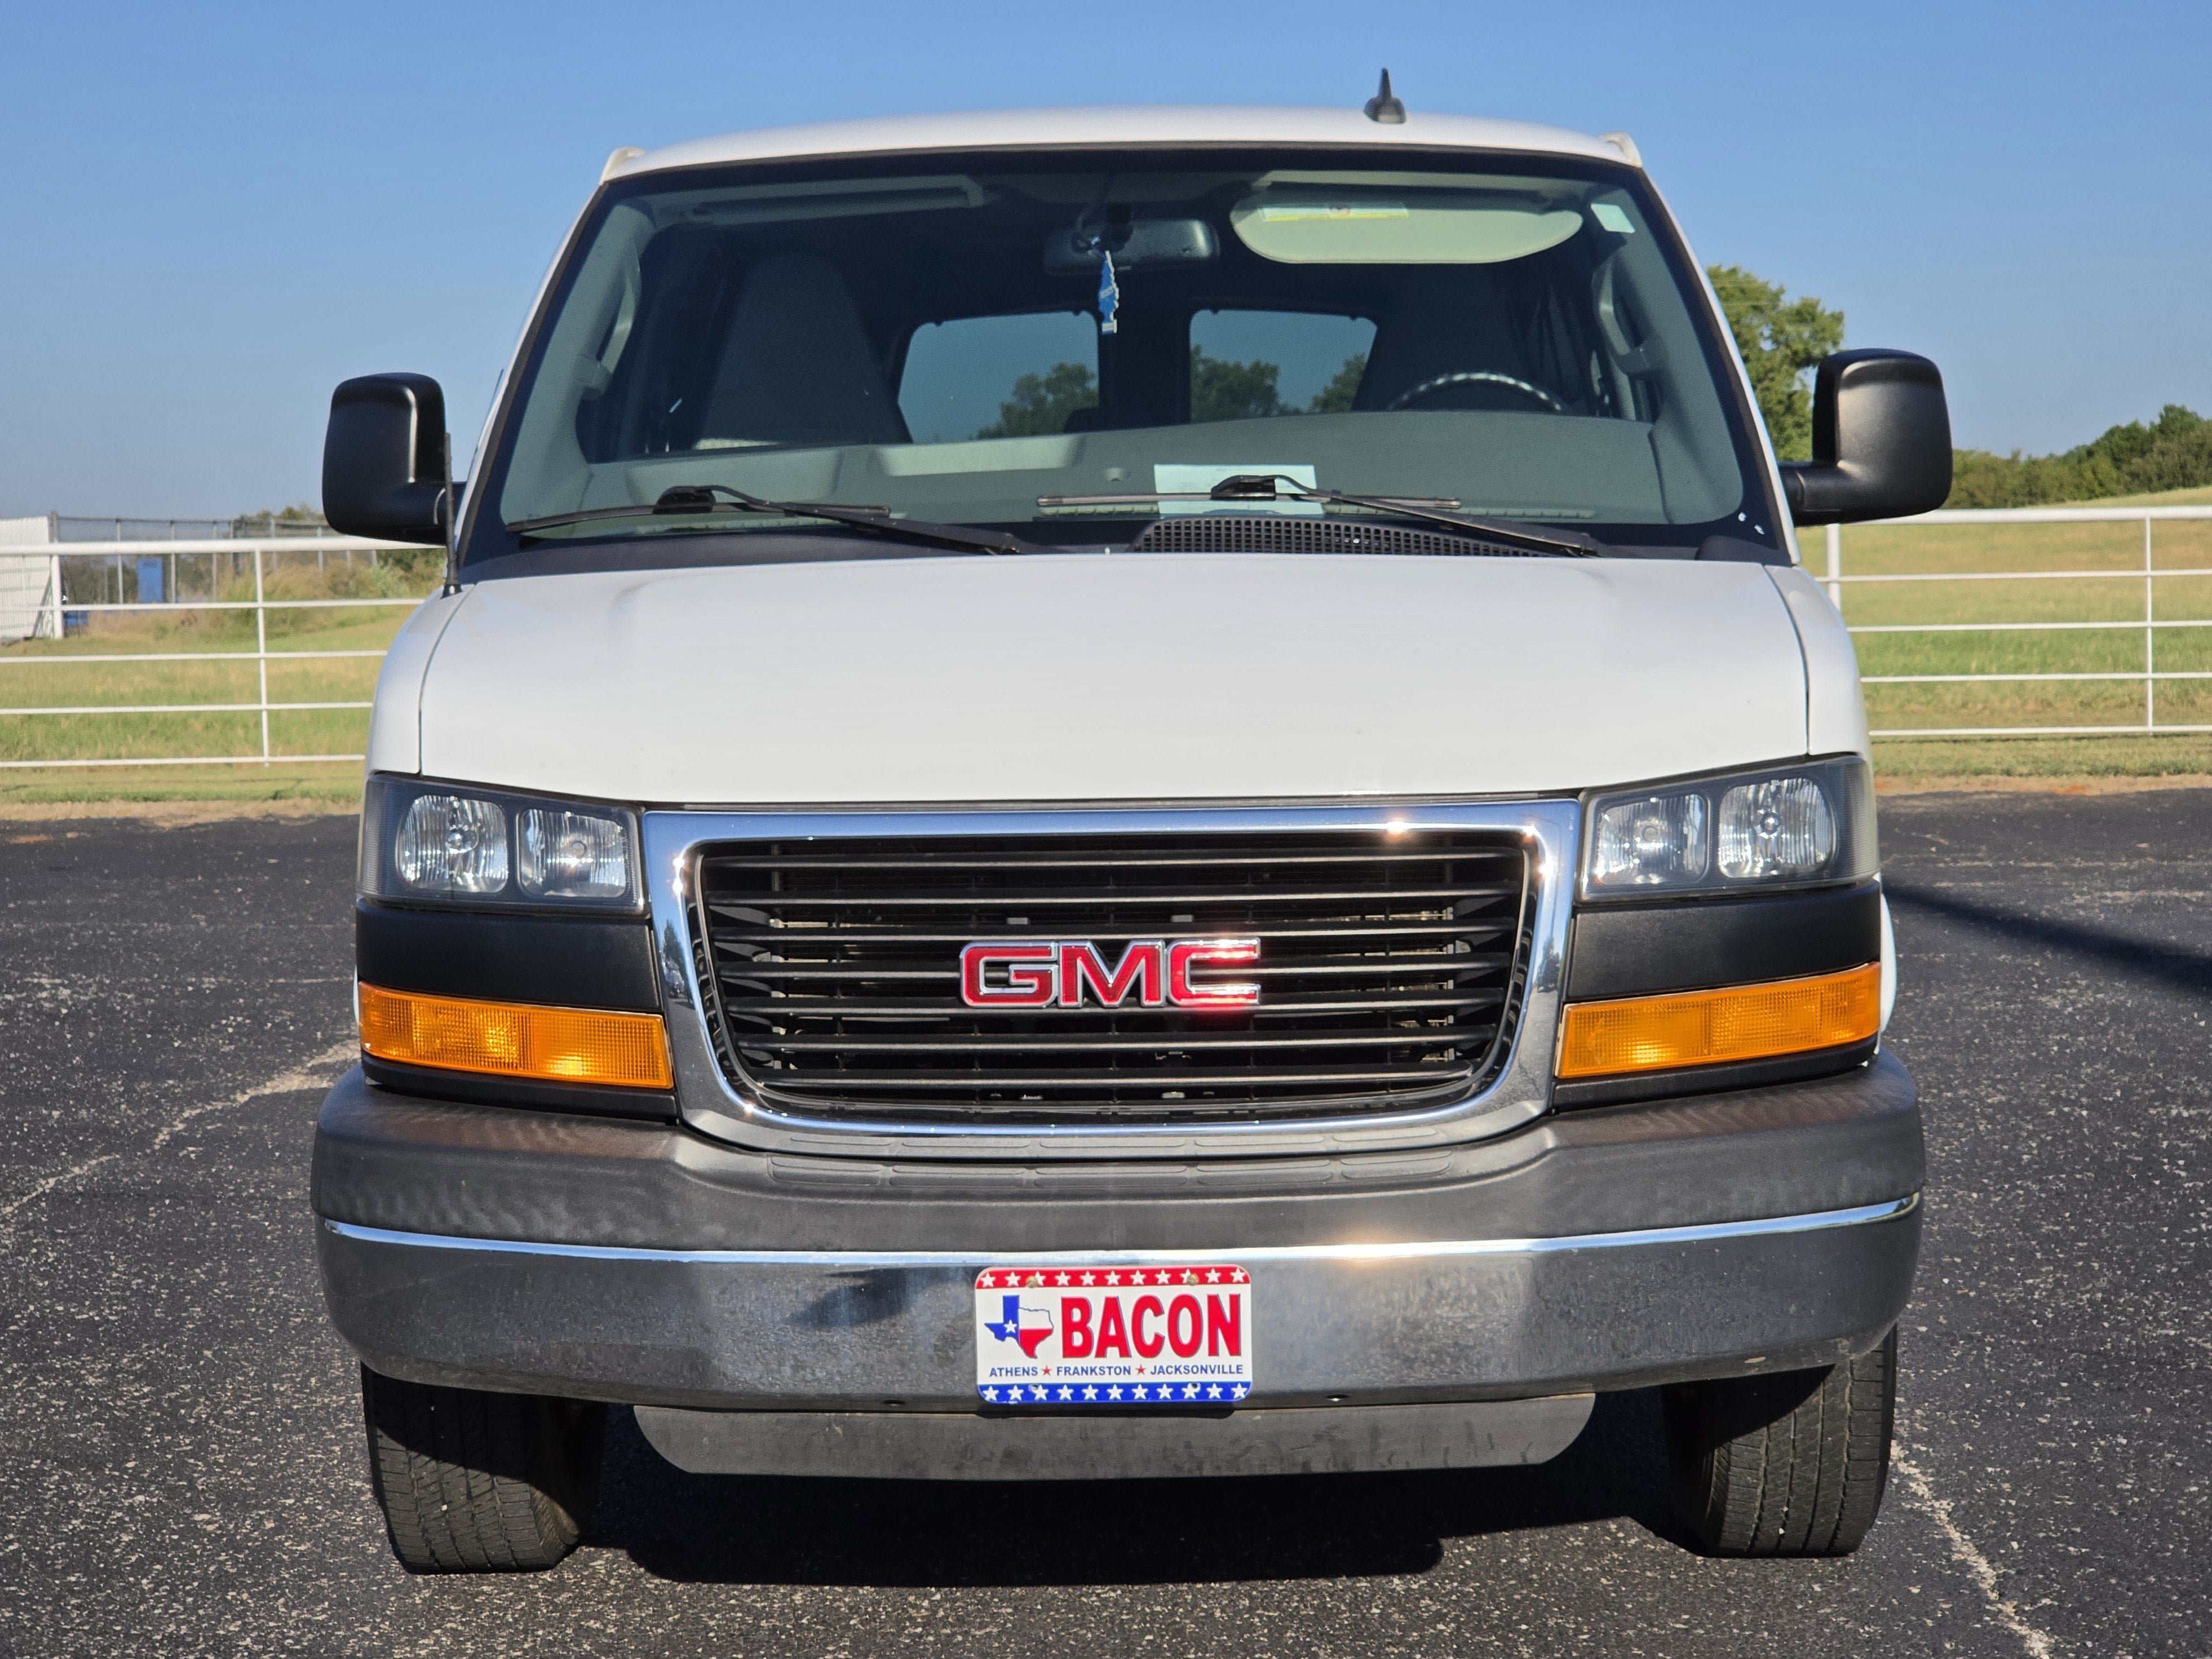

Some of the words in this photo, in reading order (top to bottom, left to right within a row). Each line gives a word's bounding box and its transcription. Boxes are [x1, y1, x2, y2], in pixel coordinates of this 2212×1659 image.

[960, 937, 1261, 1008] GMC
[1061, 1293, 1241, 1359] BACON
[989, 1365, 1039, 1377] ATHENS
[1056, 1365, 1131, 1376] FRANKSTON
[1150, 1364, 1244, 1375] JACKSONVILLE
